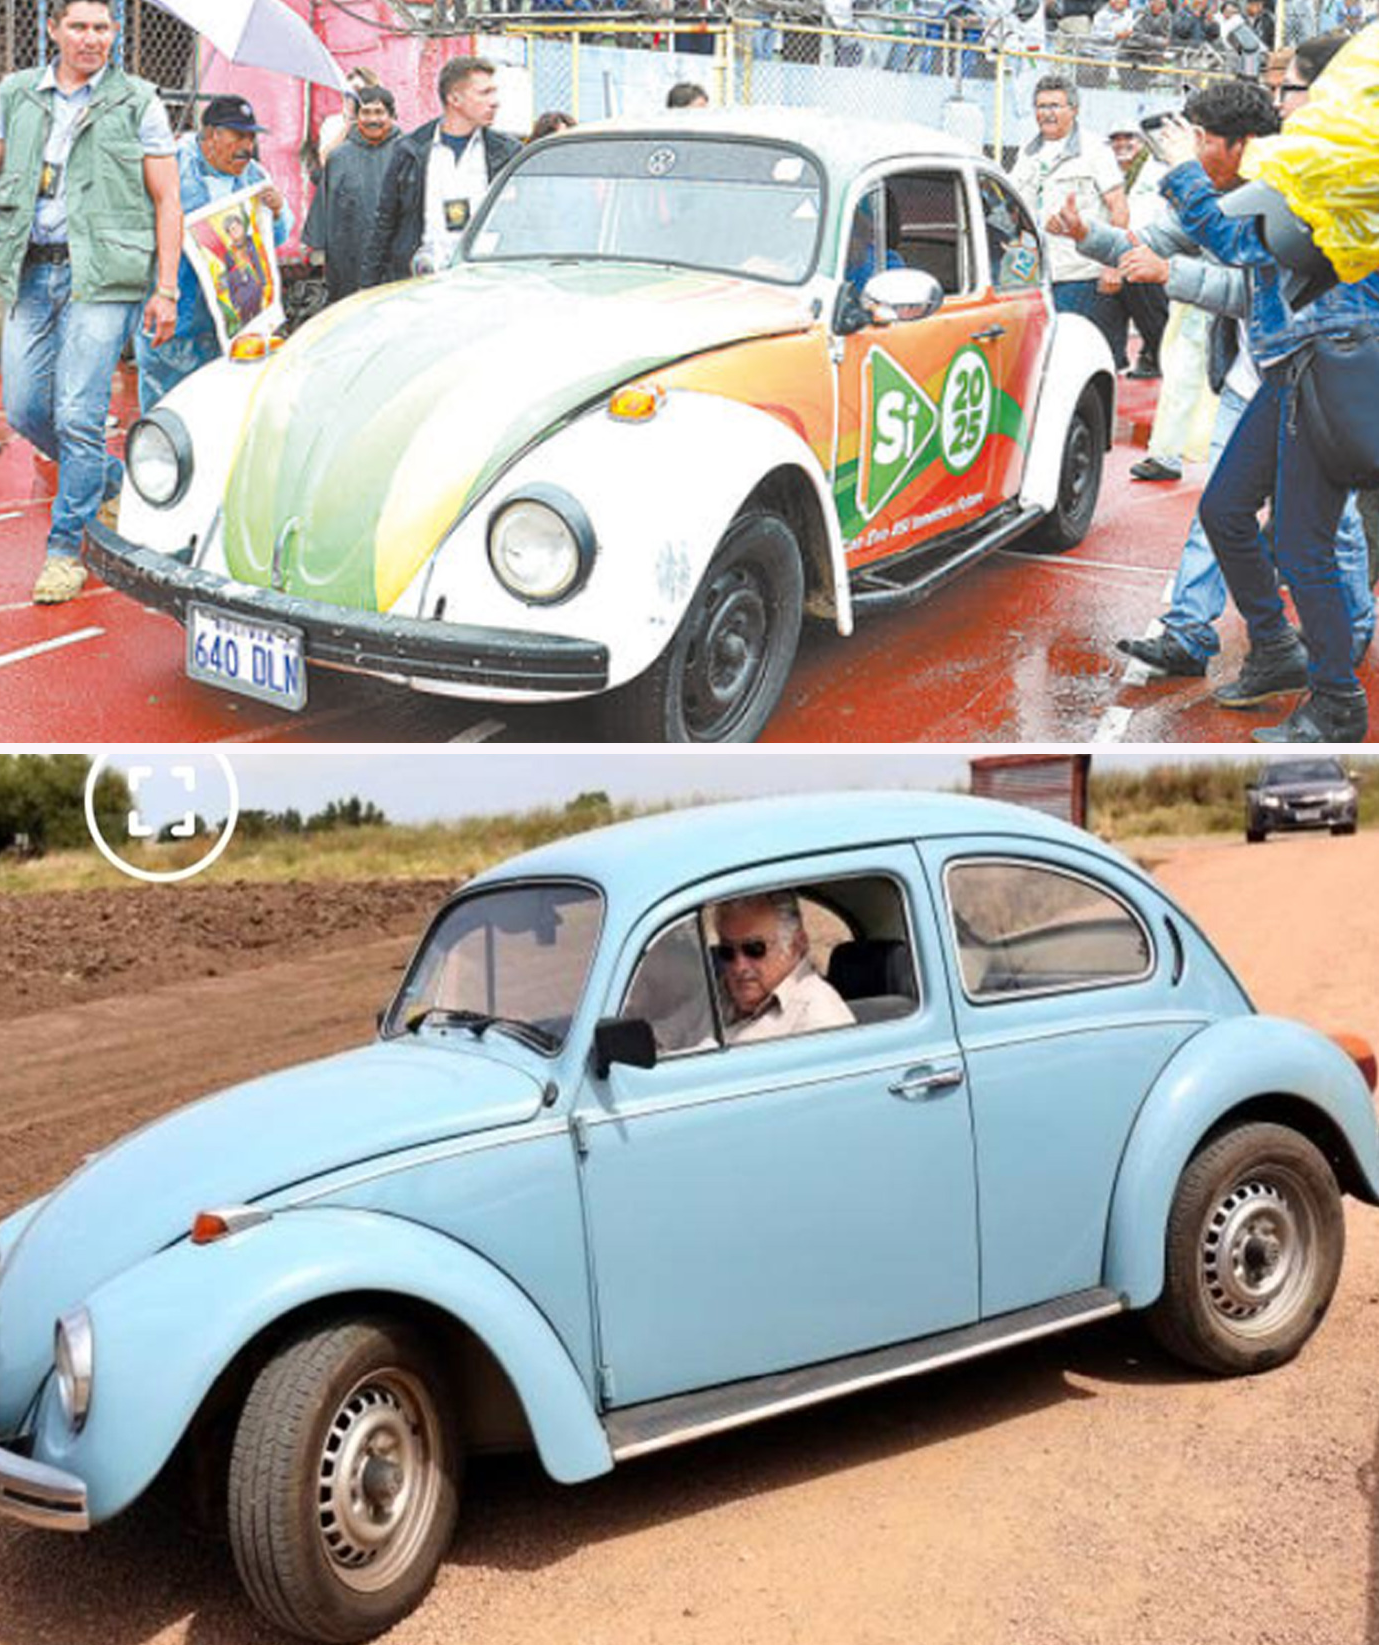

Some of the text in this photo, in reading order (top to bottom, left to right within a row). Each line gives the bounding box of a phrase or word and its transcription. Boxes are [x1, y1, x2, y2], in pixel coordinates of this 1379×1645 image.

[952, 366, 985, 413] 20
[948, 409, 983, 457] 25
[195, 632, 298, 695] 640 DLN
